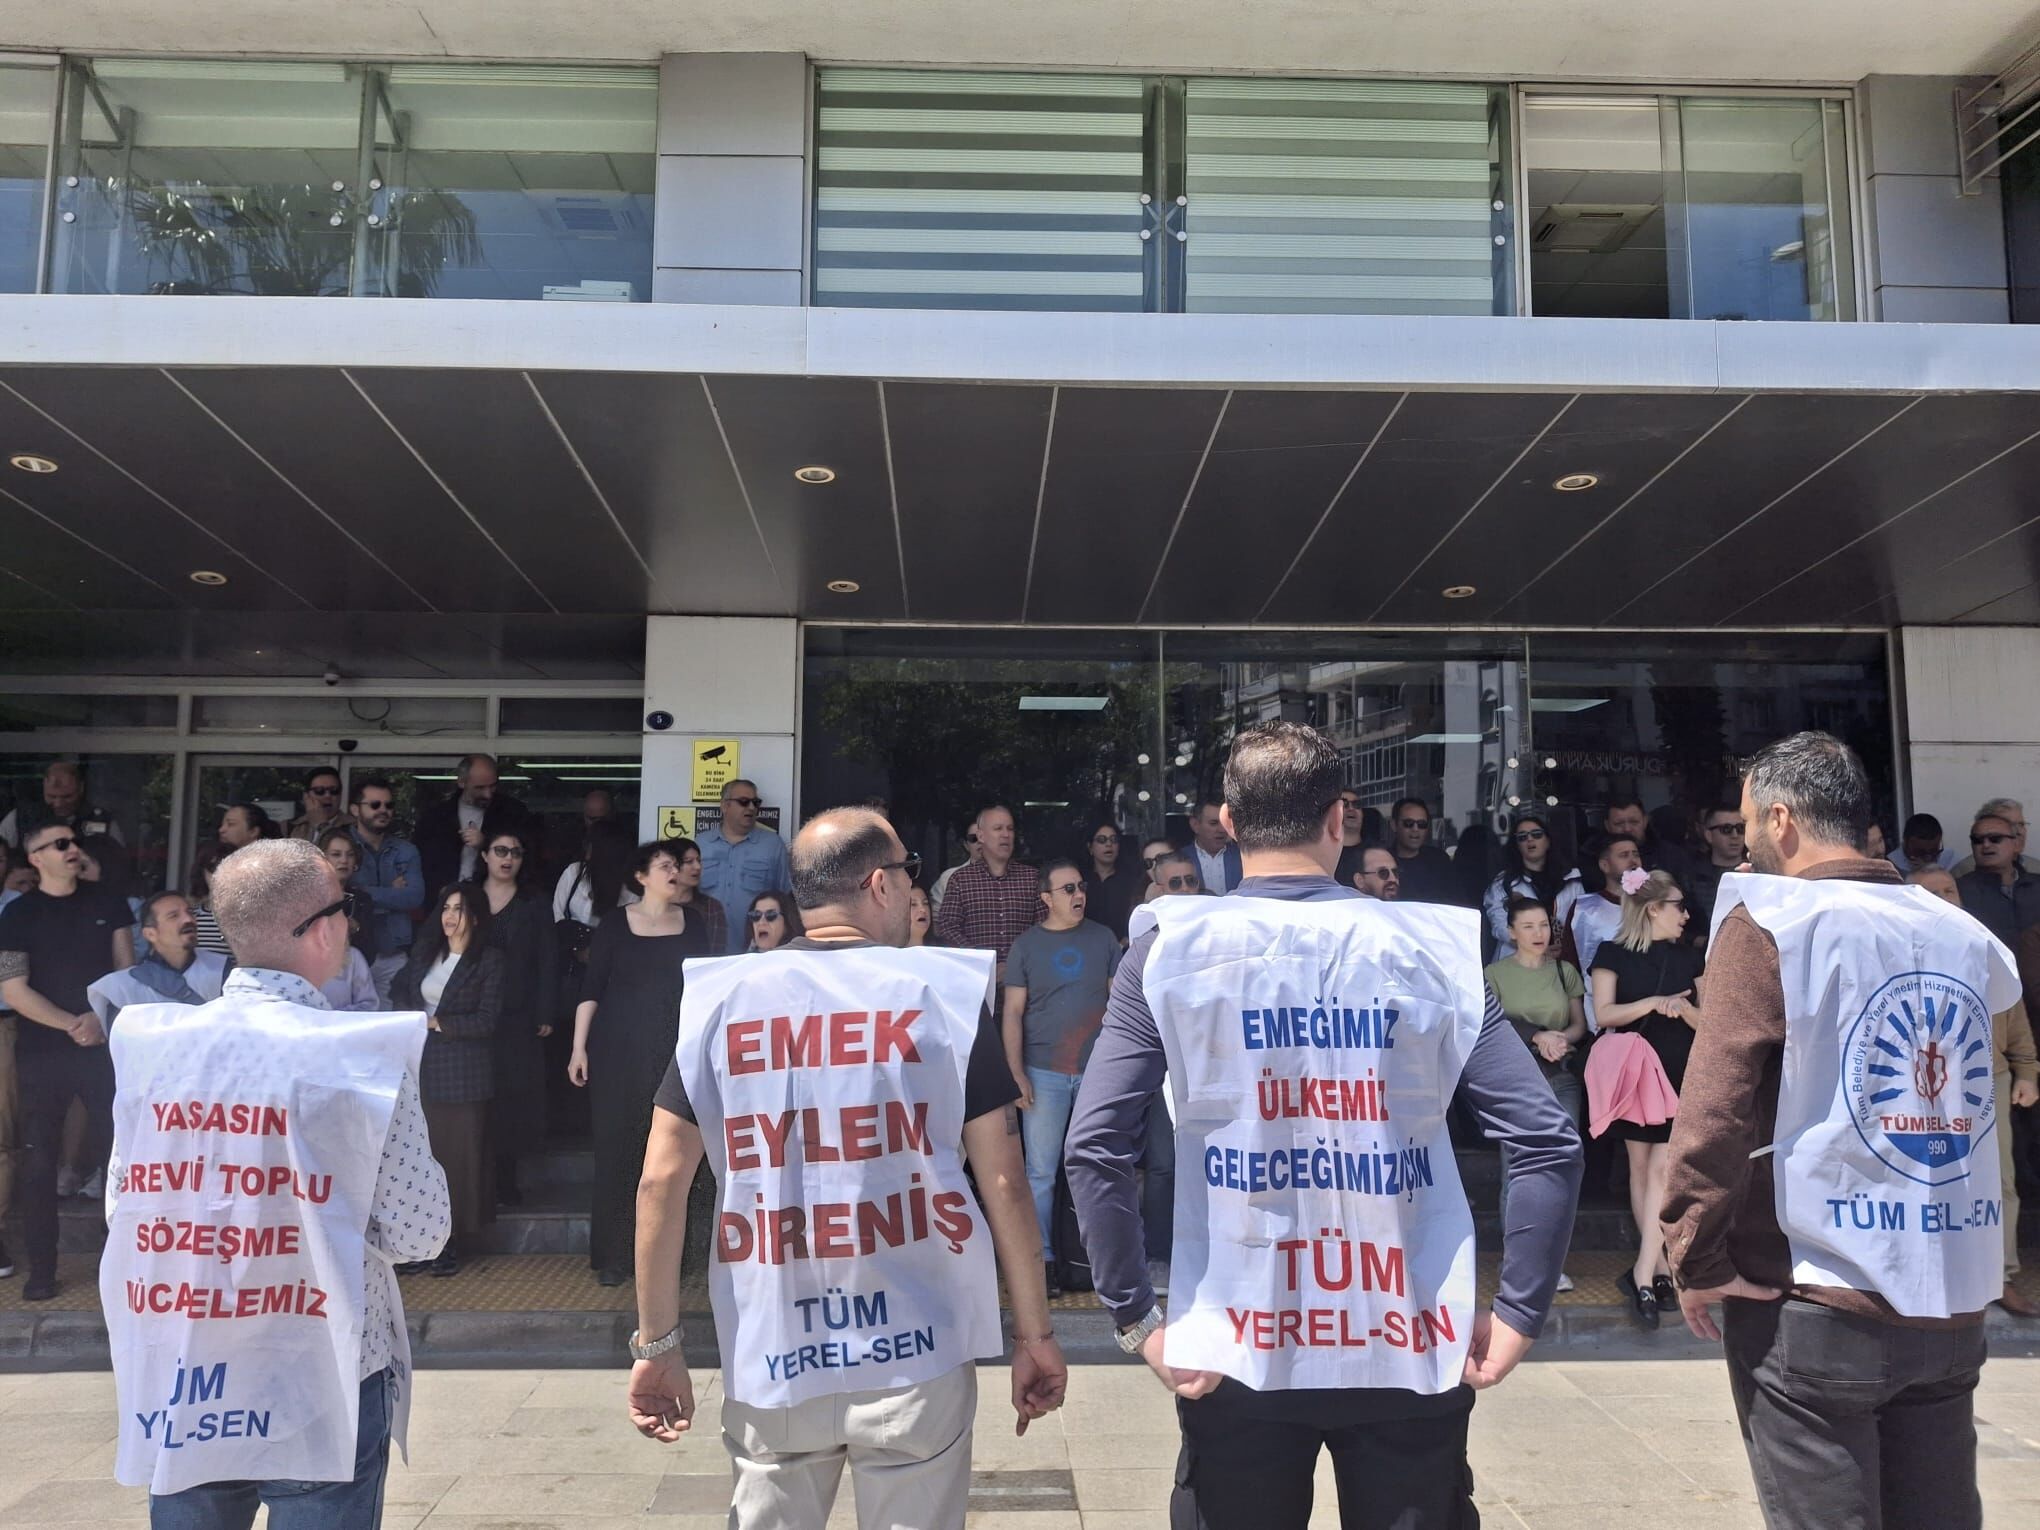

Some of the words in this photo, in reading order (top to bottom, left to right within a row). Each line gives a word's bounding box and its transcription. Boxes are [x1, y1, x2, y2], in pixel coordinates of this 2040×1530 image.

[1867, 998, 1889, 1022] Yerel
[1887, 981, 1921, 1000] Ynetim
[1924, 980, 1973, 1007] Hizmetleri
[726, 1009, 924, 1077] EMEK
[1241, 996, 1400, 1050] EMEĞİMİZ
[1863, 1025, 1872, 1038] ve
[1852, 1039, 1868, 1093] Belediye
[152, 1101, 288, 1136] YAŞASIN
[1857, 1096, 1870, 1124] Tüm
[725, 1101, 934, 1172] EYLEM
[219, 1164, 333, 1204] TOPLU
[1204, 1136, 1400, 1196] GELECEĞİMİZ
[717, 1172, 974, 1266] DİRENİŞ
[1826, 1193, 1905, 1231] TÜM
[1277, 1228, 1405, 1297] TÜM
[794, 1288, 889, 1333] TÜM
[1225, 1305, 1456, 1354] YEREL-SEN
[765, 1325, 935, 1381] YEREL-SEN
